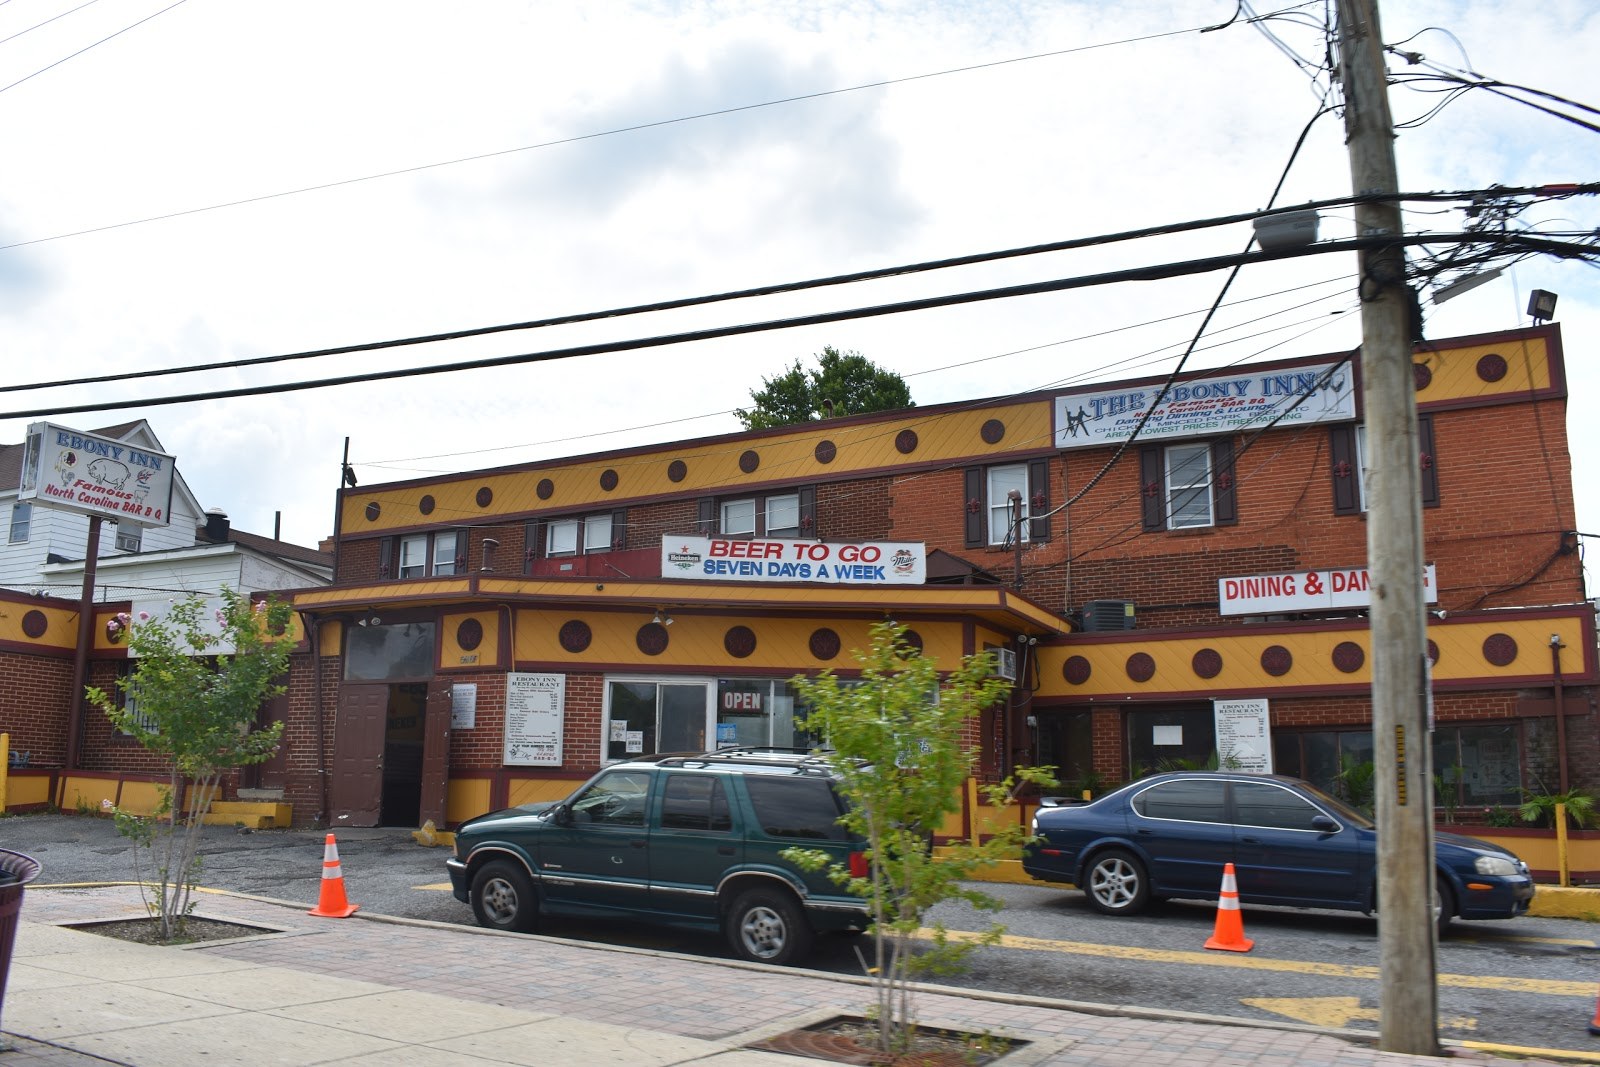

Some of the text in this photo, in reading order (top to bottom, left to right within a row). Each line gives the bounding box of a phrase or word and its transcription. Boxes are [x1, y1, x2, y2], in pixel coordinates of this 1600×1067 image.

[1089, 392, 1146, 421] THE
[1260, 371, 1316, 397] INN
[1167, 396, 1237, 409] Famous
[1169, 403, 1216, 414] Carolina
[1220, 399, 1245, 408] BAR
[1249, 397, 1266, 405] BQ
[1228, 403, 1275, 414] Lounge
[1140, 425, 1180, 435] LOWEST
[1183, 421, 1218, 432] PRICES
[1227, 417, 1254, 427] FREE
[1159, 418, 1203, 427] MINCED
[1206, 413, 1241, 422] PORK
[56, 431, 163, 470] EBONY INN
[73, 479, 133, 500] Famous
[45, 484, 75, 499] North
[78, 492, 119, 510] Carolina
[122, 502, 143, 515] BAR
[144, 507, 153, 518] B
[670, 554, 699, 562] Heineken
[709, 540, 882, 563] BEER TO GO
[703, 559, 885, 580] SEVEN DAYS A WEEK
[890, 555, 917, 567] Miller
[1225, 575, 1296, 600] DINING
[1303, 572, 1324, 595] &
[725, 692, 761, 709] OPEN
